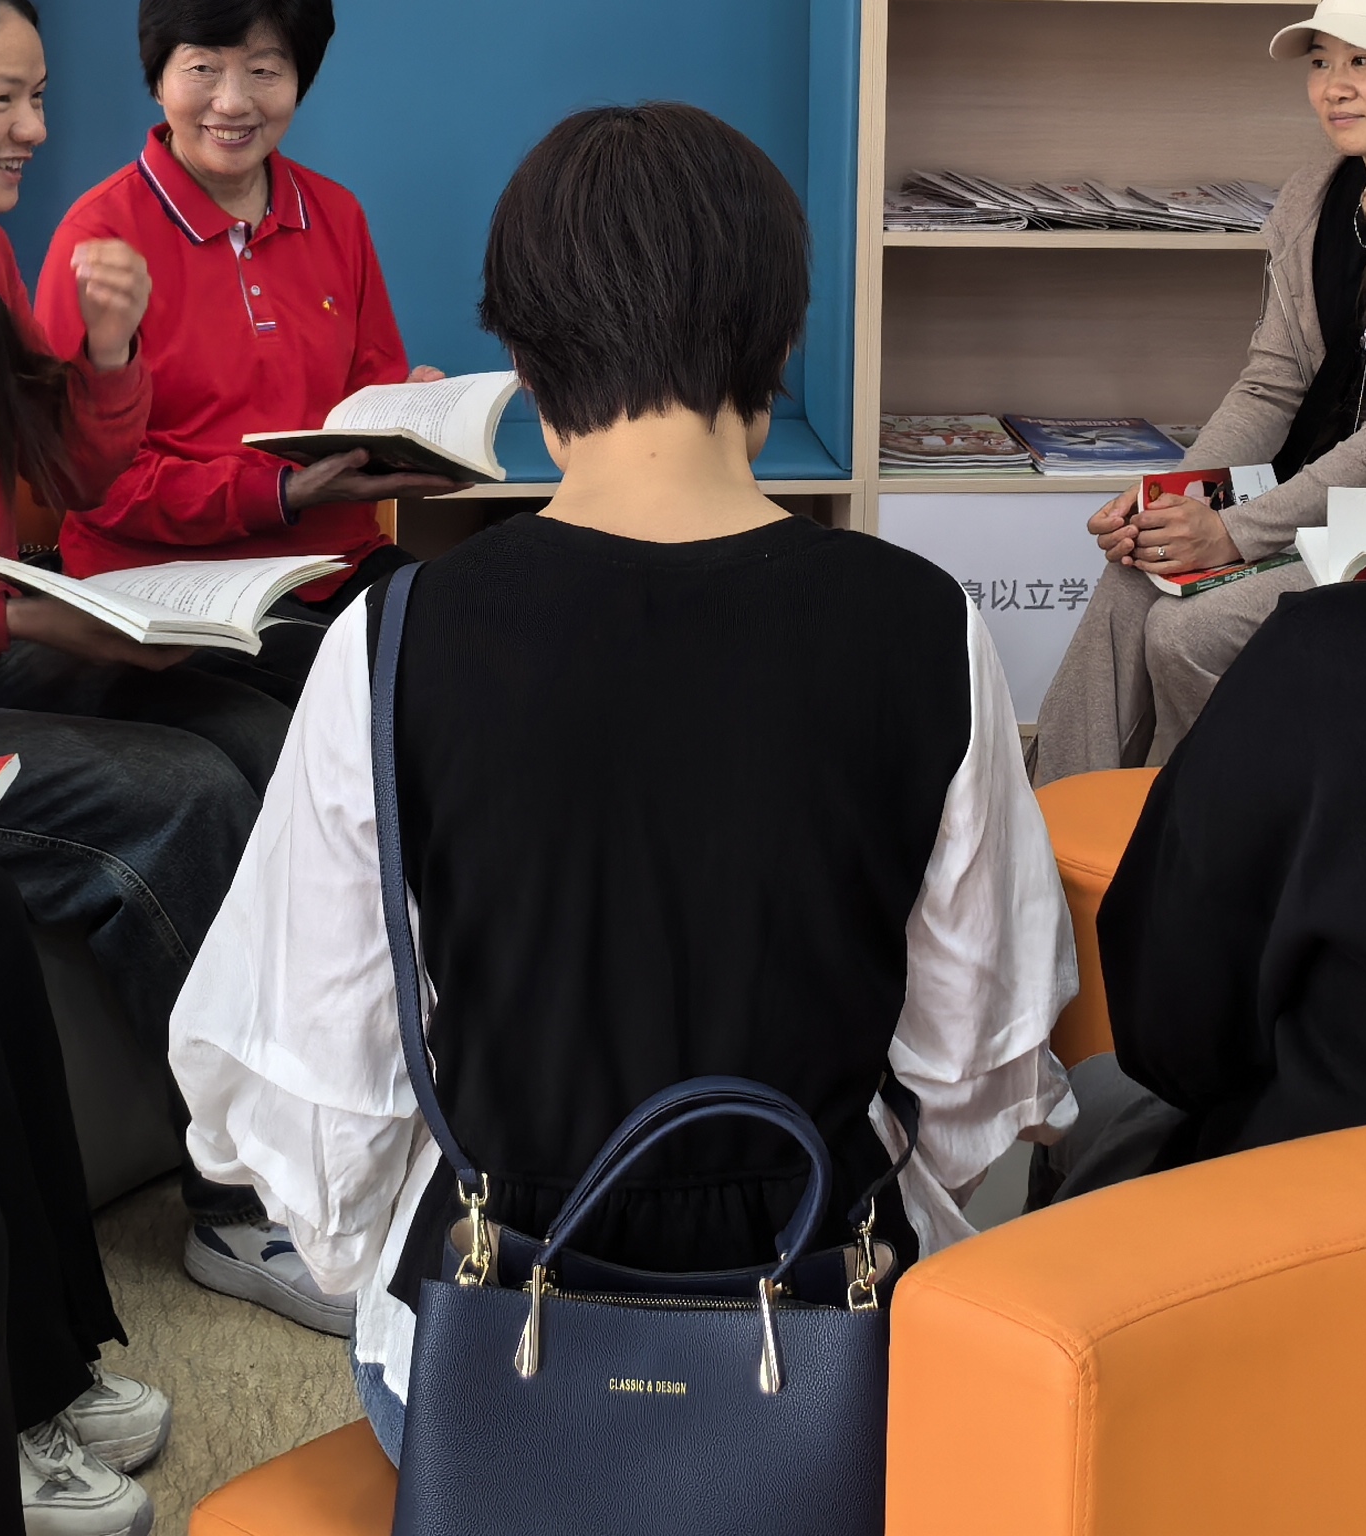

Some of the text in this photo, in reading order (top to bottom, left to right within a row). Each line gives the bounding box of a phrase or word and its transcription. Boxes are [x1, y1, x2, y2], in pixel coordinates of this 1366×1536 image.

[964, 577, 1101, 612] 身以立学
[609, 1378, 687, 1394] CLASSIC & DESIGN
